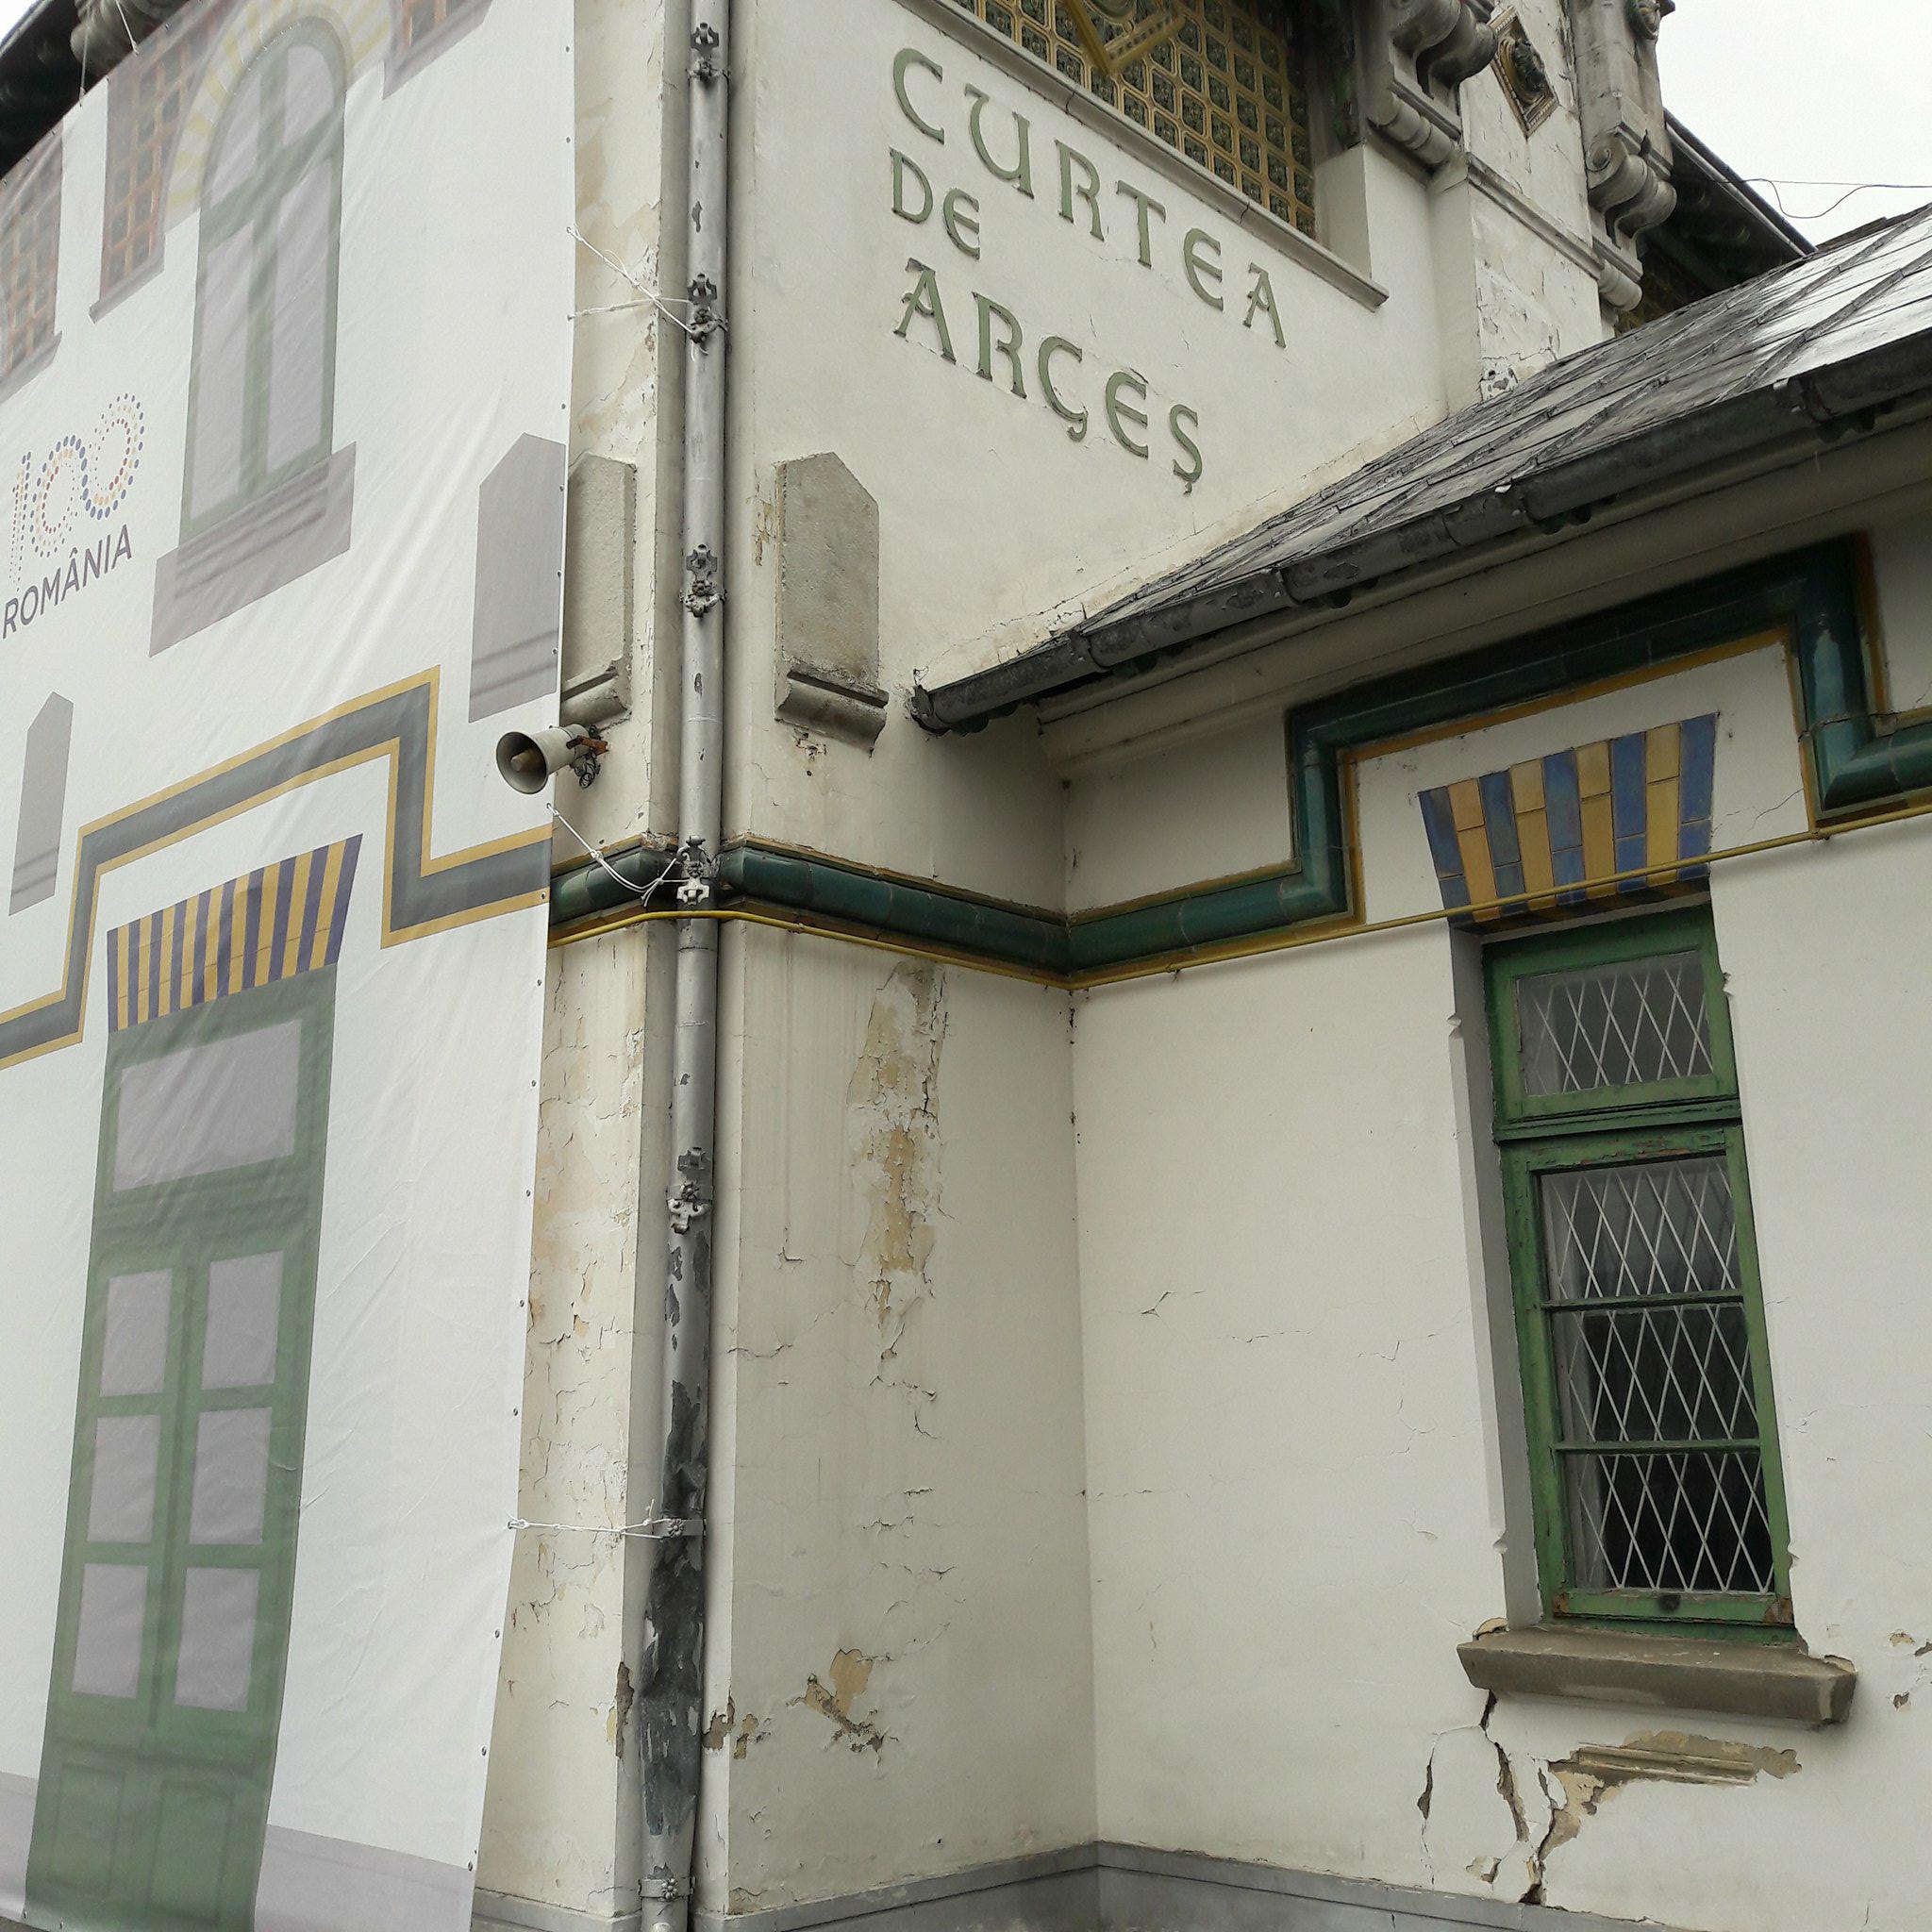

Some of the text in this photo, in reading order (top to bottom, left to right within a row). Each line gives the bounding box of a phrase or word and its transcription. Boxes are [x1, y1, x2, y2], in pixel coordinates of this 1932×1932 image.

[890, 146, 980, 259] DE
[892, 48, 1287, 348] CURTEA
[3, 524, 132, 639] ROMÂNIA
